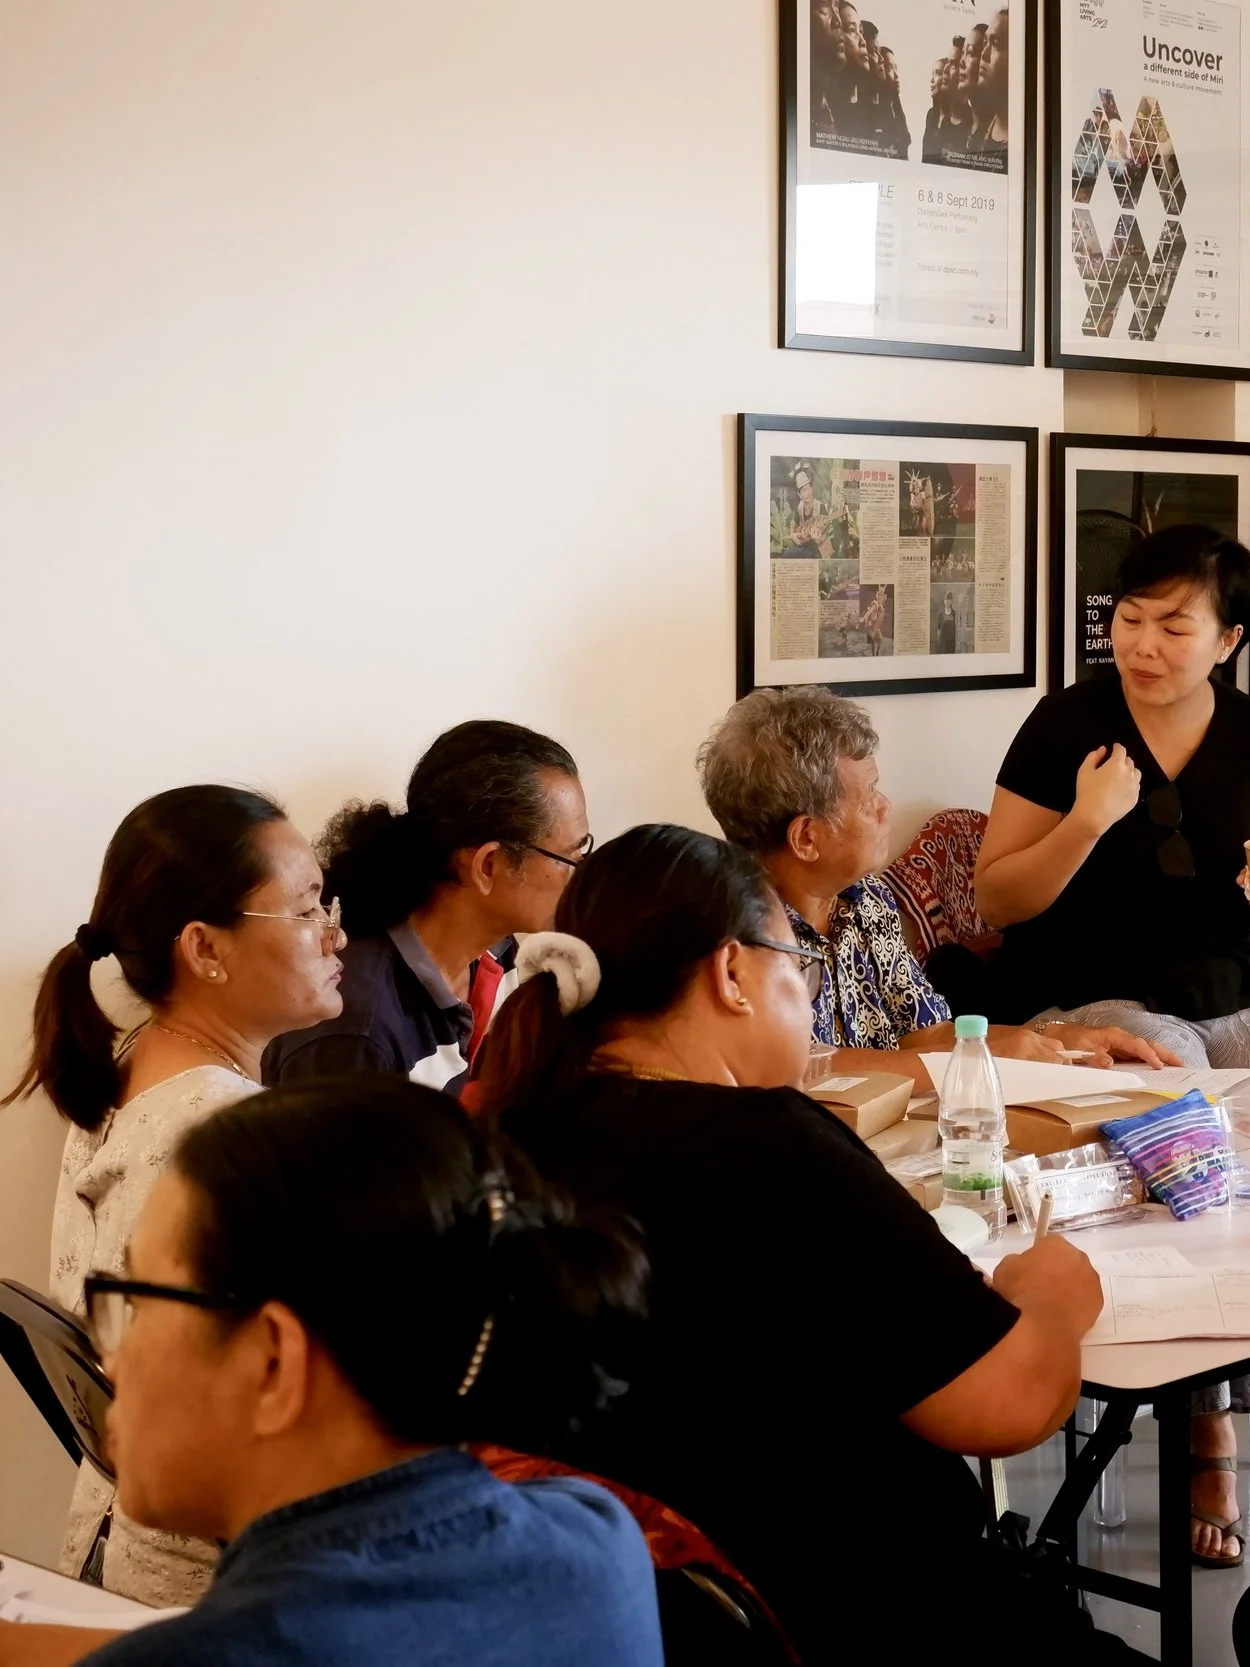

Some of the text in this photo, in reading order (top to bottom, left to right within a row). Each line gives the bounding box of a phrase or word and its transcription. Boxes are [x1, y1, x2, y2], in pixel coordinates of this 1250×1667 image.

[1080, 8, 1096, 16] LIVING
[1143, 35, 1222, 71] Uncover
[1150, 63, 1182, 78] different
[1184, 70, 1199, 80] side
[1201, 72, 1208, 82] of
[1210, 74, 1224, 85] Miri
[1176, 82, 1194, 91] culture
[918, 190, 994, 210] 6 & 8 Sept 2019
[1086, 594, 1113, 606] SONG
[1086, 610, 1099, 620] TO
[1086, 624, 1104, 635] THE
[1086, 638, 1113, 650] EARTH
